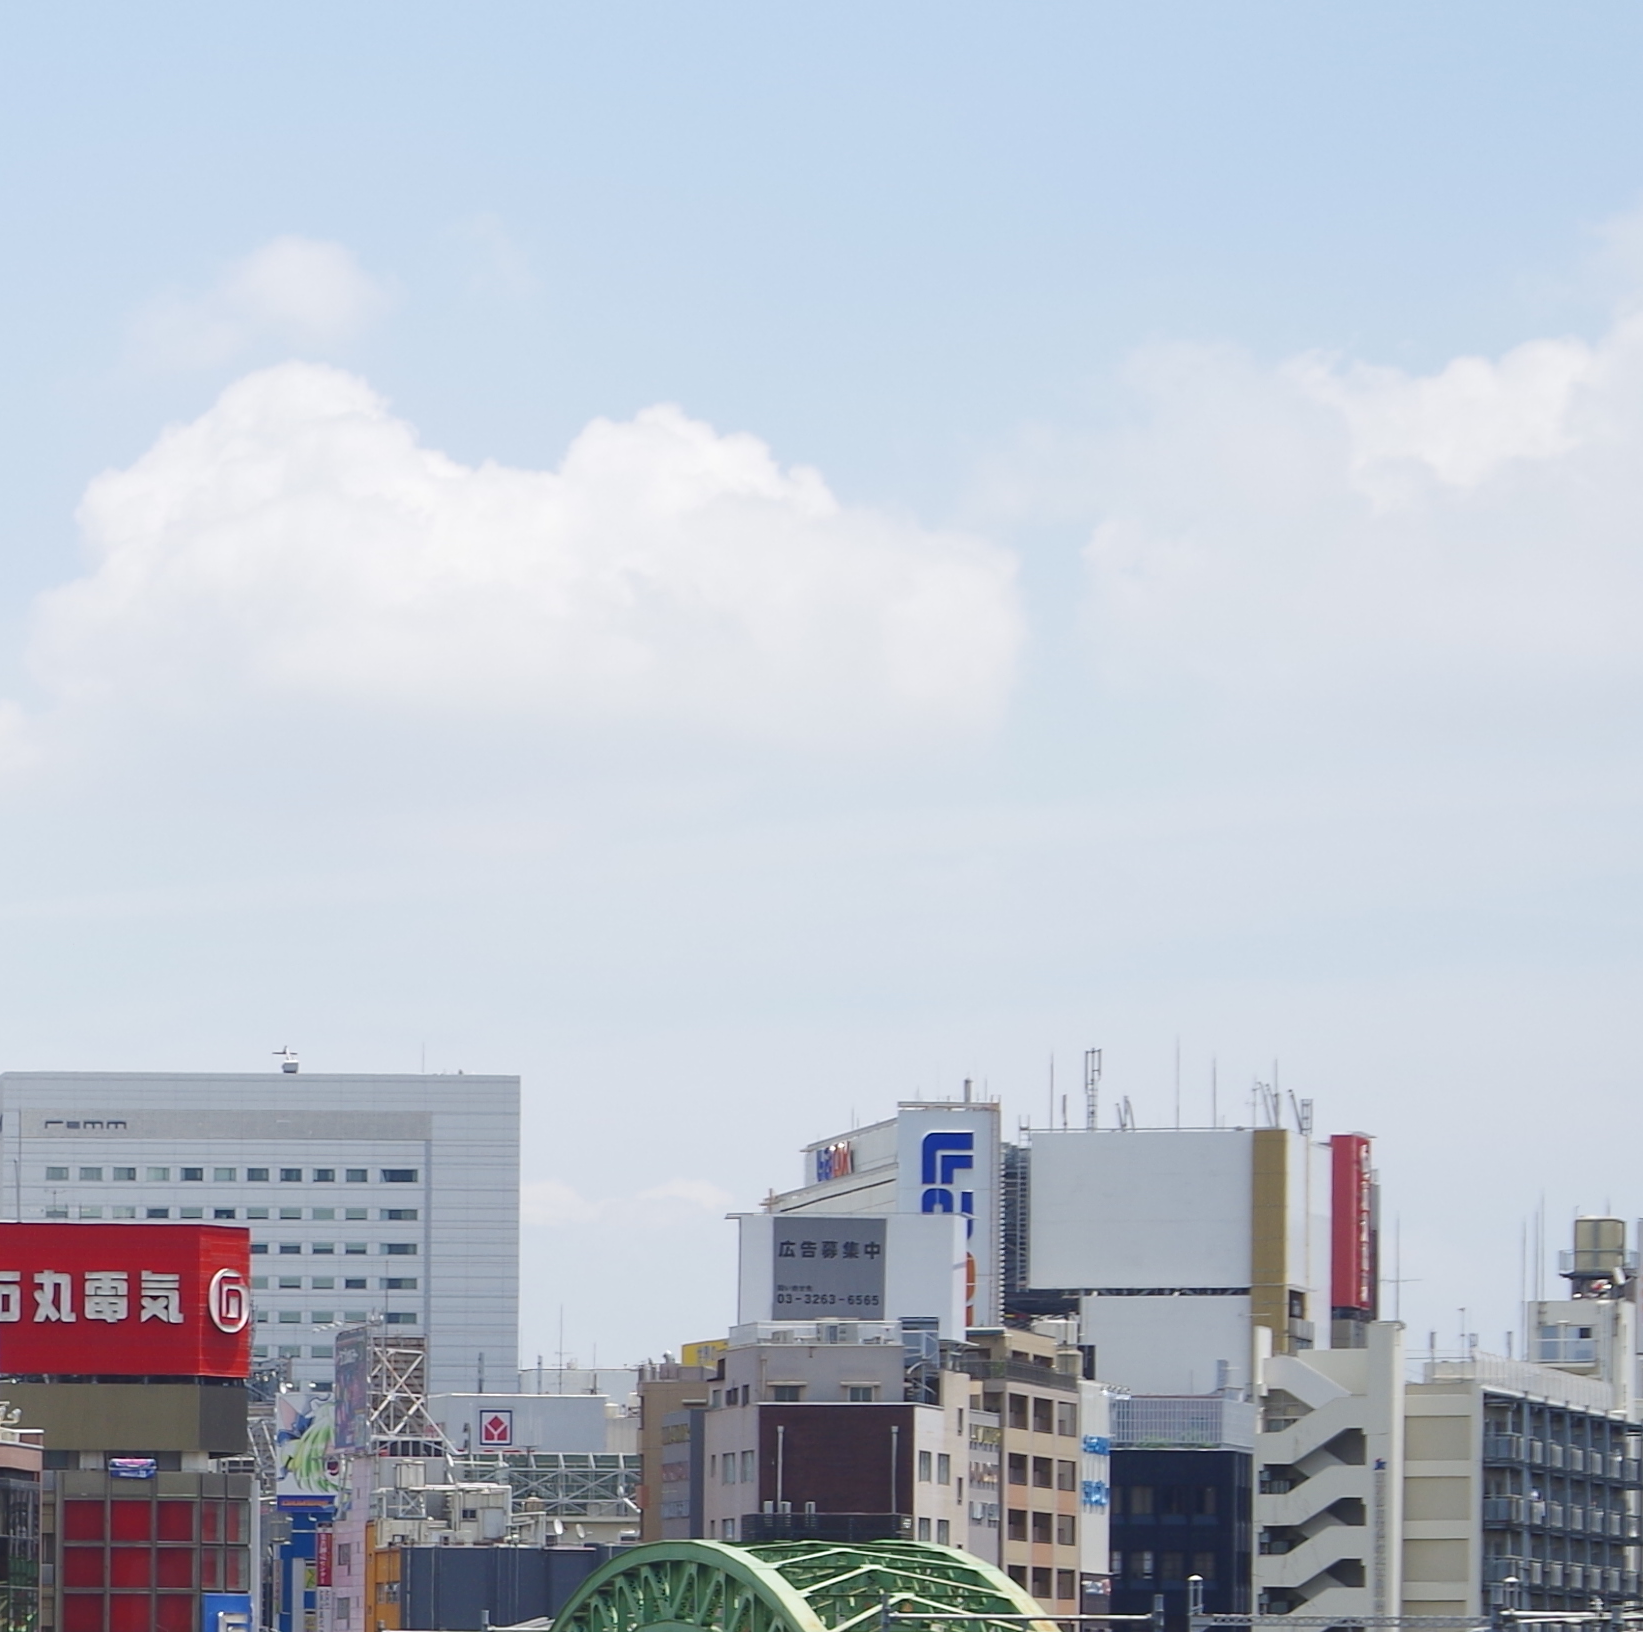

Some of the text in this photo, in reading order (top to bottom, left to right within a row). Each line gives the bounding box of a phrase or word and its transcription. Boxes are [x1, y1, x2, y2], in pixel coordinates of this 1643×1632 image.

[778, 1240, 881, 1260] 広告募集中
[777, 1293, 880, 1306] 03-3263-6565
